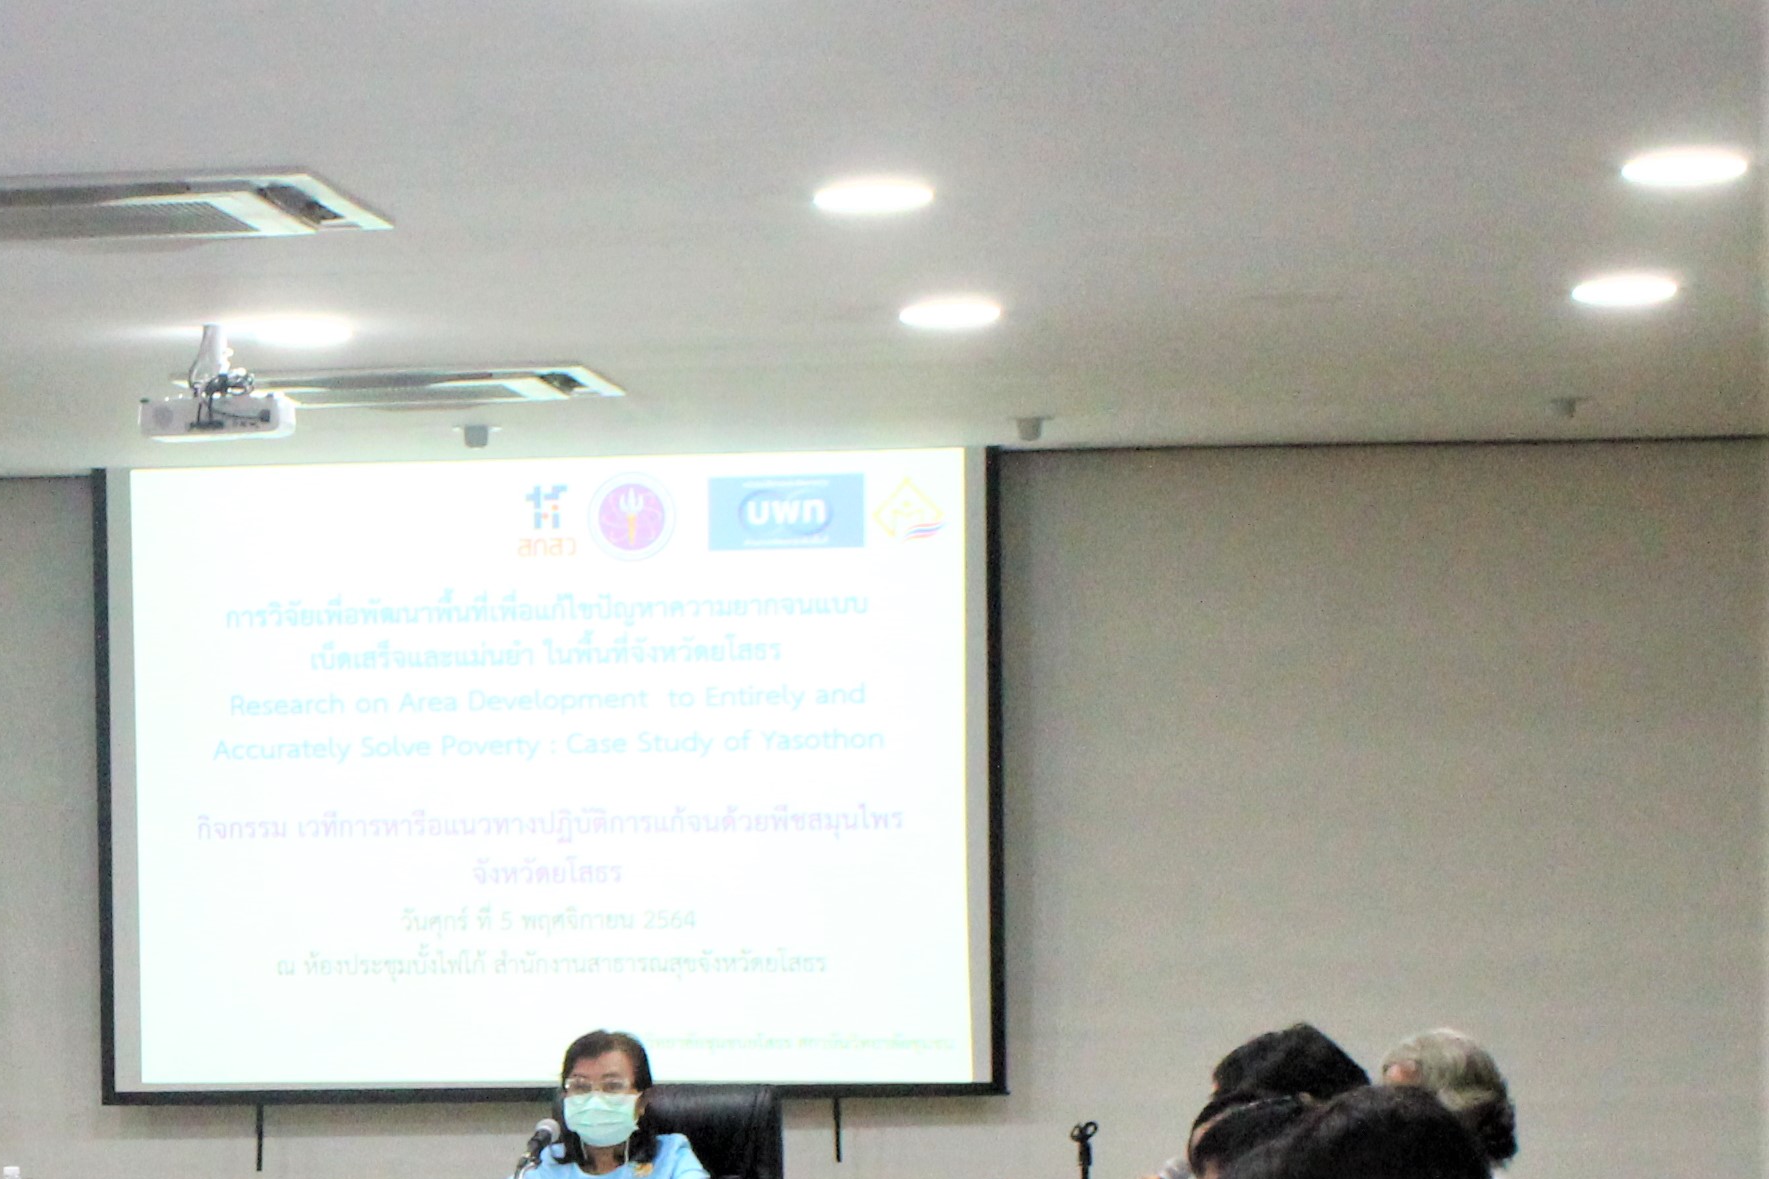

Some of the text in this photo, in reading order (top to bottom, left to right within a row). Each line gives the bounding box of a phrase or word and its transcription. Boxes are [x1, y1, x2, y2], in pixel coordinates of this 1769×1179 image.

[230, 682, 866, 716] Research on Area Development to Entirely and
[213, 736, 352, 764] Accurately
[361, 735, 432, 758] Solve
[441, 734, 541, 762] Poverty
[566, 732, 628, 754] Case
[637, 731, 714, 757] Study
[724, 729, 753, 752] of
[761, 729, 885, 751] Yasothon
[472, 854, 622, 885] จังหวัดยโสธร
[476, 904, 494, 929] ที่
[500, 909, 514, 931] 5
[520, 905, 635, 936] พฤศจิกายน
[643, 909, 697, 929] 2564
[277, 959, 296, 976] ณ
